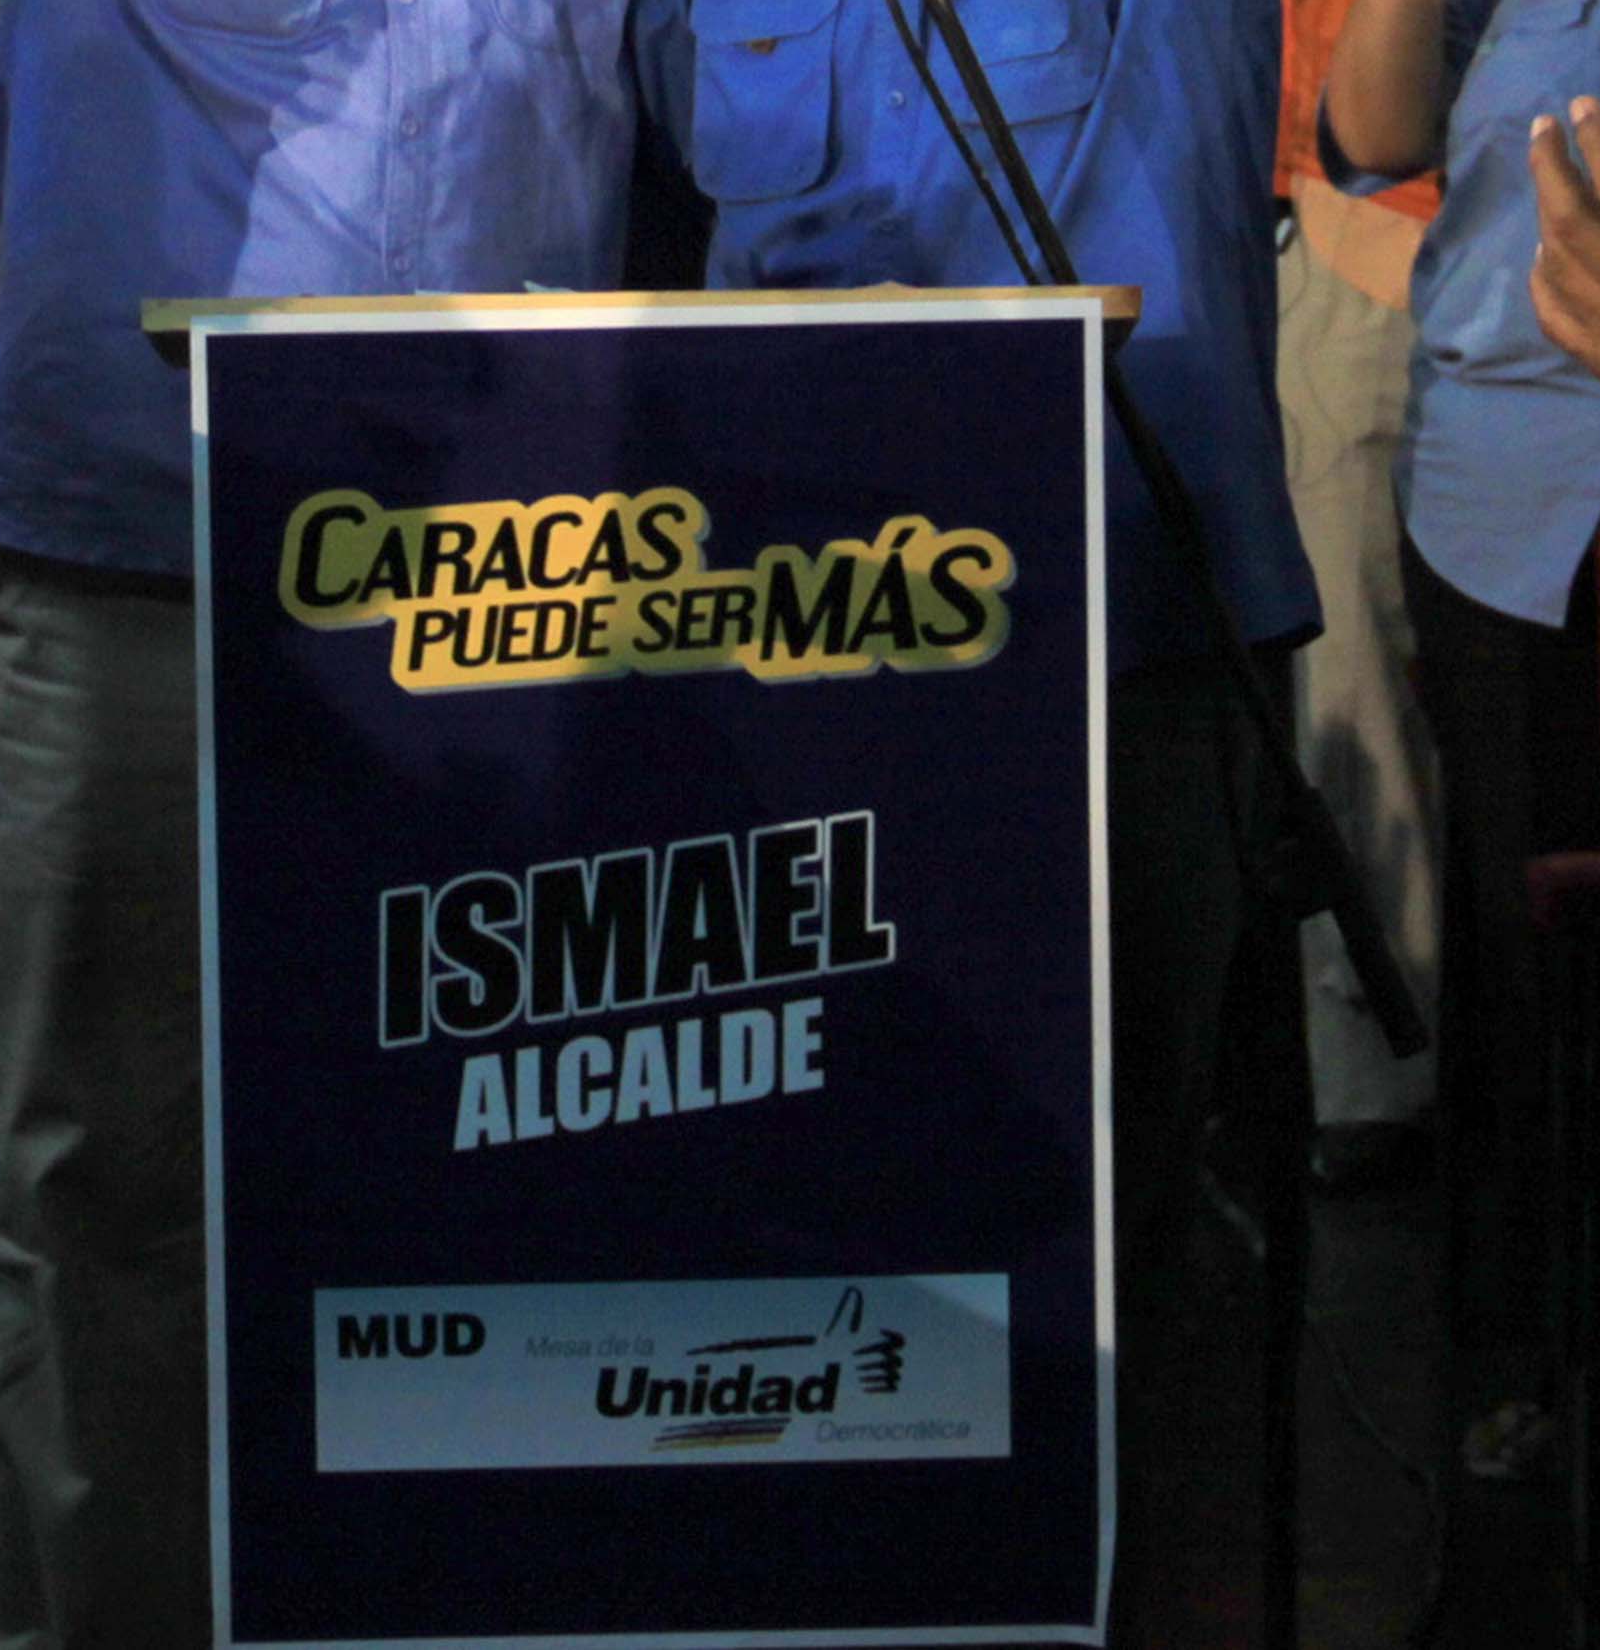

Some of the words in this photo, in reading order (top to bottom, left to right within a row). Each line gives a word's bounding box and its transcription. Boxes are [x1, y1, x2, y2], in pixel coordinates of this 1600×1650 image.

[294, 501, 688, 609] CARACAS
[407, 594, 616, 672] PUEDE
[631, 584, 758, 653] SER
[758, 526, 993, 662] MÁS
[379, 809, 896, 1048] ISMAEL
[453, 998, 825, 1151] ALCALDE
[336, 1313, 487, 1360] MUD
[595, 1363, 842, 1419] Unidad
